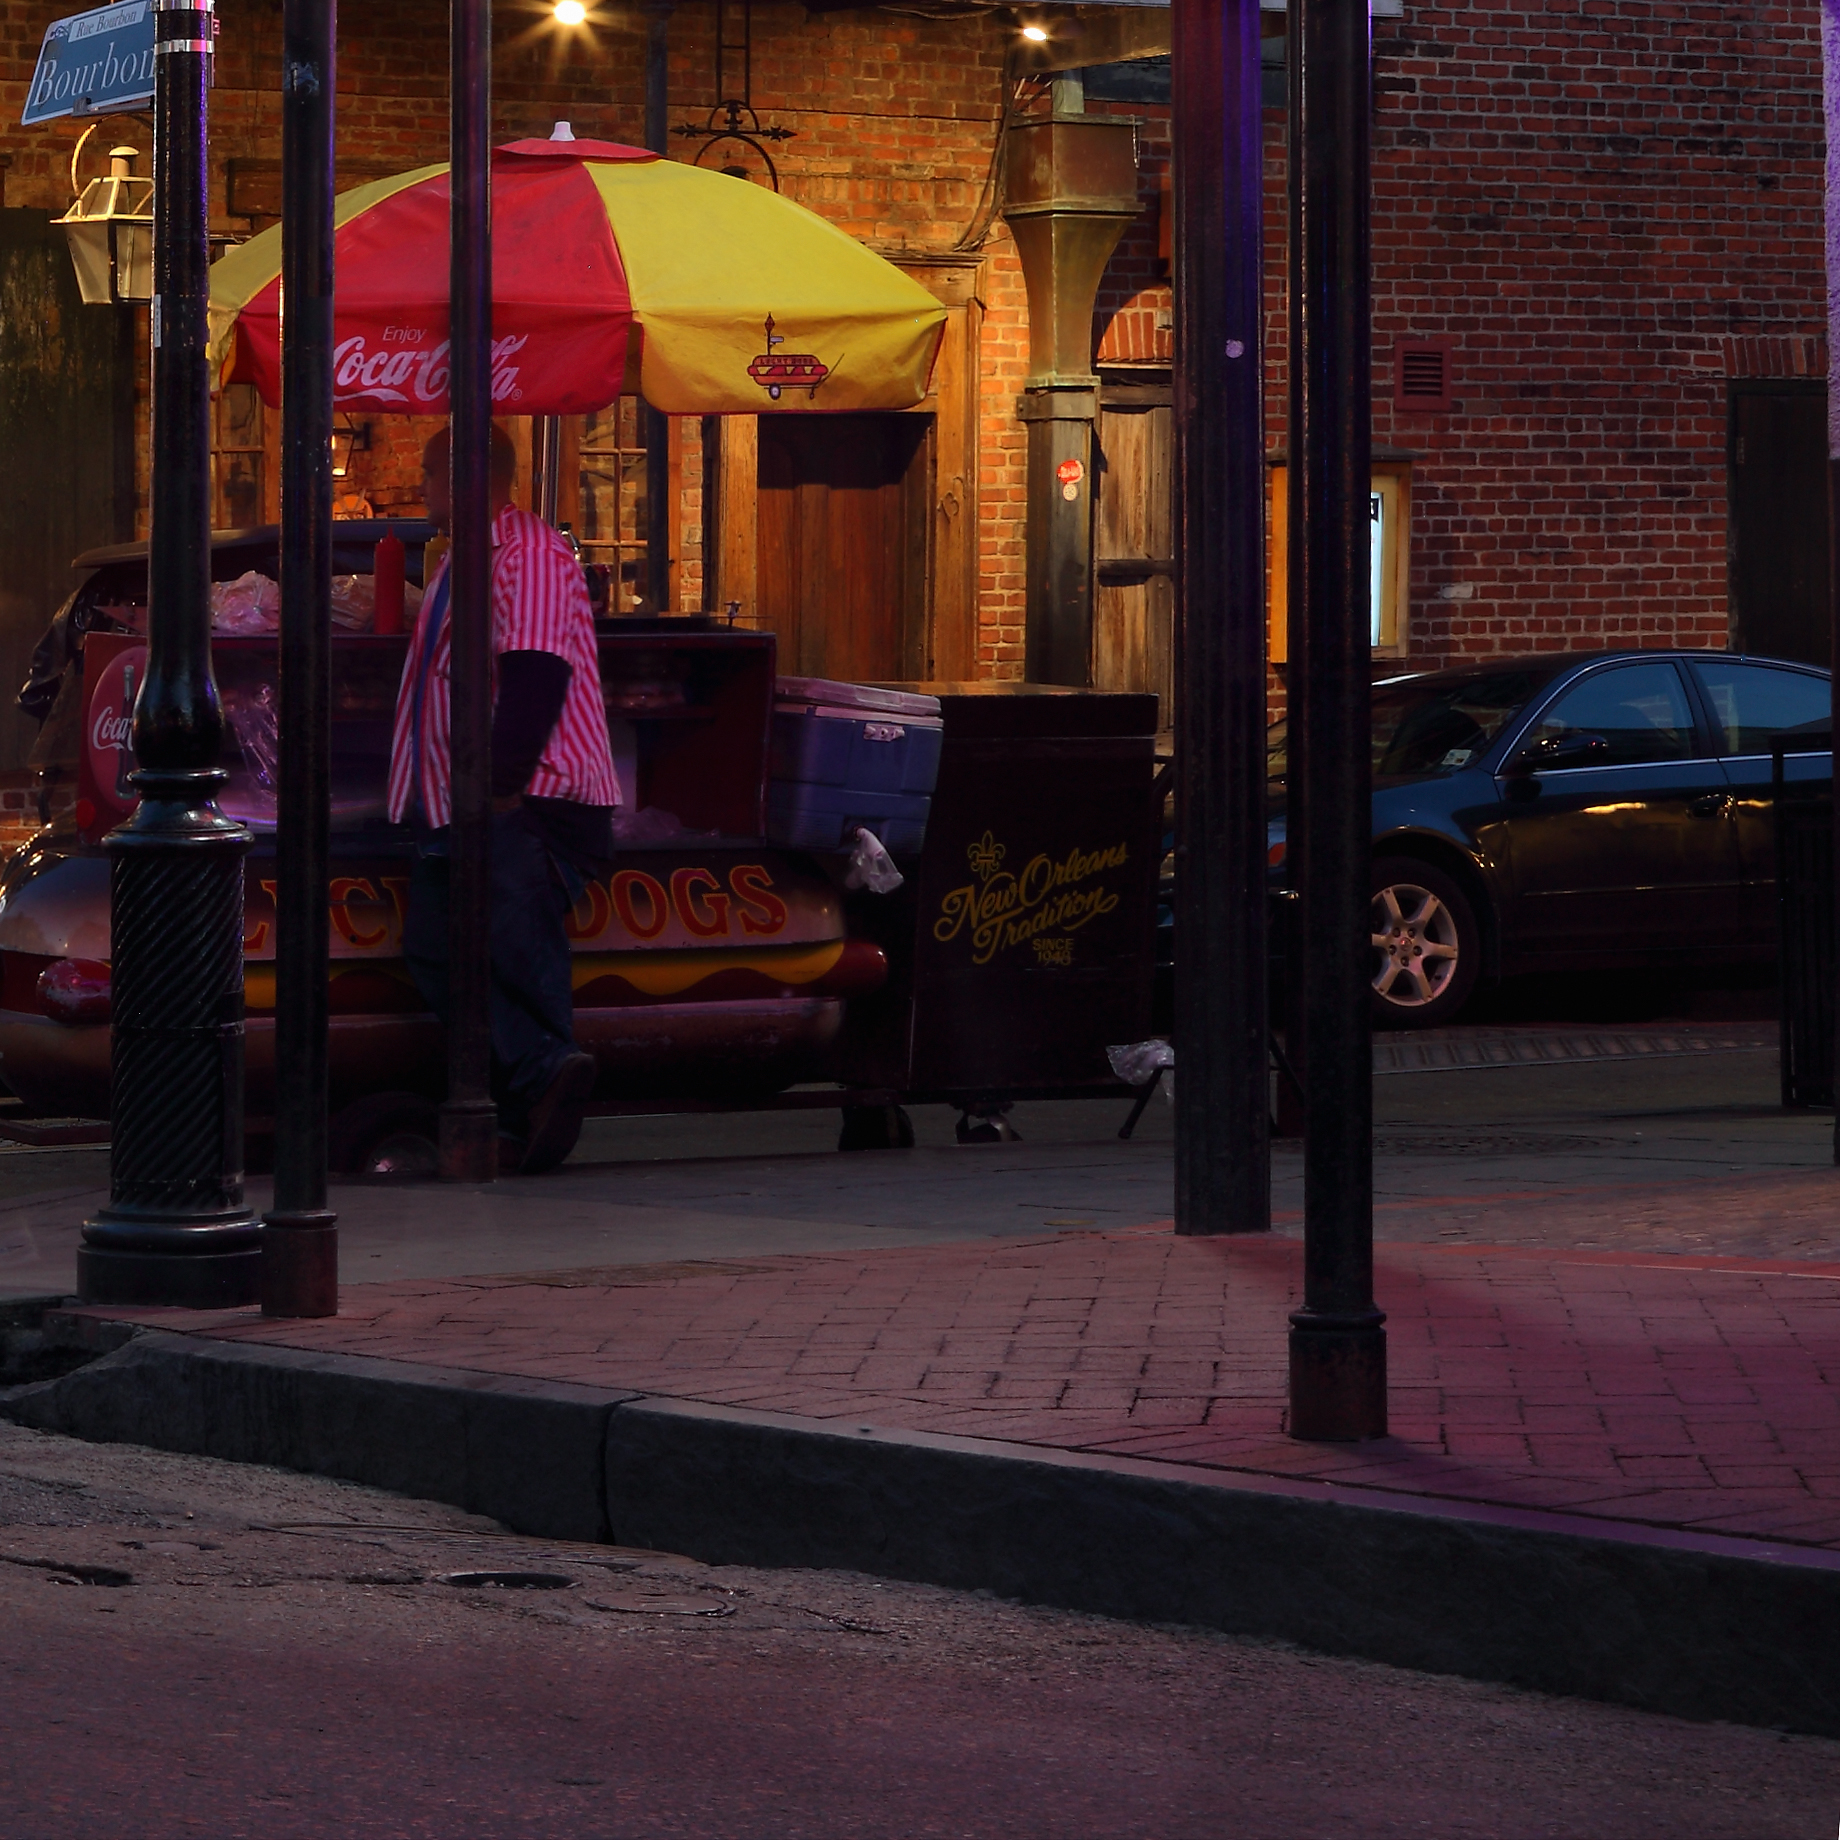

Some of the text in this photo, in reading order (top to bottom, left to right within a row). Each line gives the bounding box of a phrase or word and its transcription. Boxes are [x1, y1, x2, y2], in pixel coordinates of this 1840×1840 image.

[76, 10, 137, 39] Rue Bourbon
[32, 41, 155, 106] Bourbon
[382, 325, 427, 344] Enjoy
[567, 864, 789, 943] DOGS
[934, 841, 1129, 942] New Orleans
[972, 886, 1119, 965] Tradition
[1032, 938, 1074, 951] SINCE
